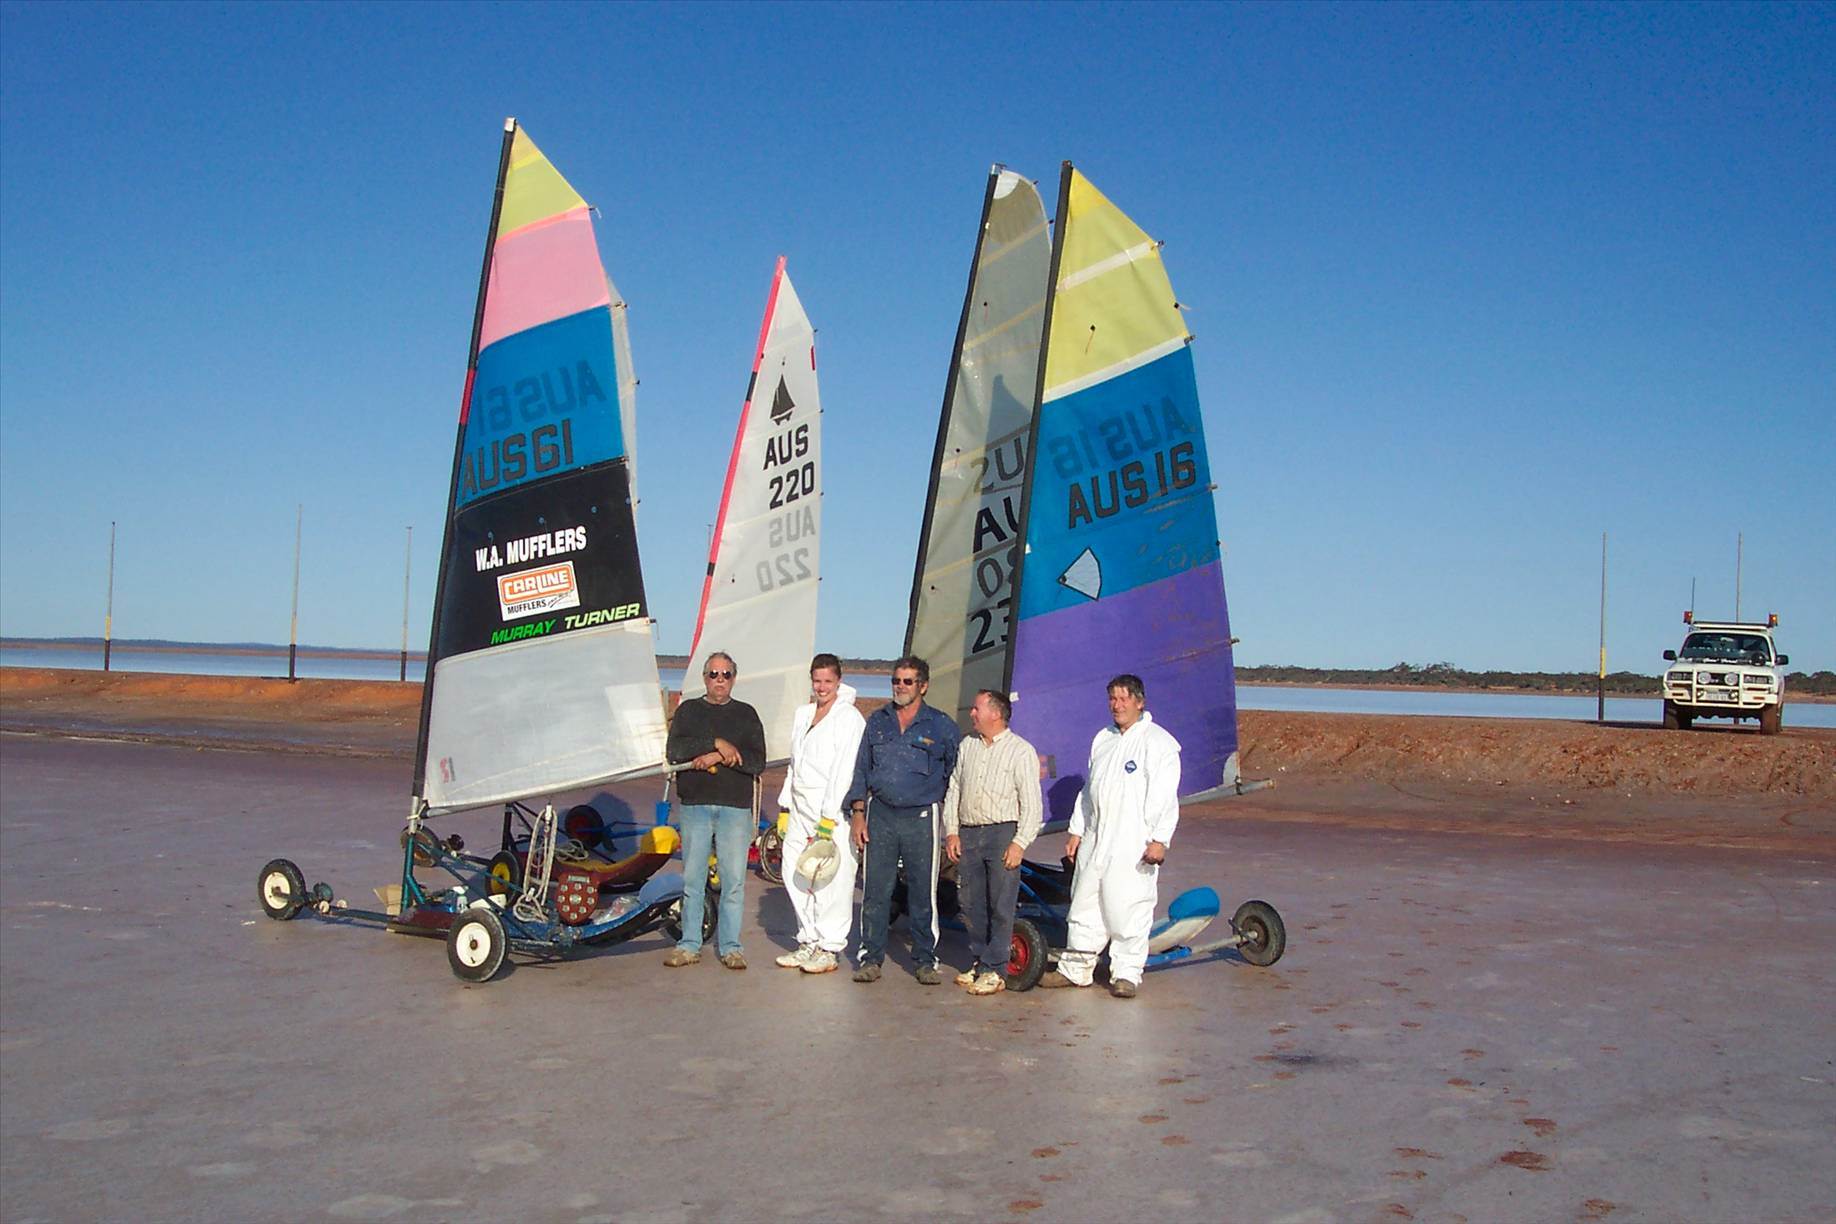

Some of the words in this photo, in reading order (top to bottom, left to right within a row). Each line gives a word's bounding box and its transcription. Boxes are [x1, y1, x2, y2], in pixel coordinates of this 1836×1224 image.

[763, 423, 809, 471] AUS
[769, 460, 815, 510] 220
[972, 495, 1020, 554] AU
[475, 545, 503, 572] W.A.
[506, 525, 587, 565] MUFFLERS
[503, 569, 570, 600] CARLINE
[507, 599, 547, 615] MUFFLERS
[490, 619, 556, 645] MURRAY
[564, 602, 641, 630] TURNER
